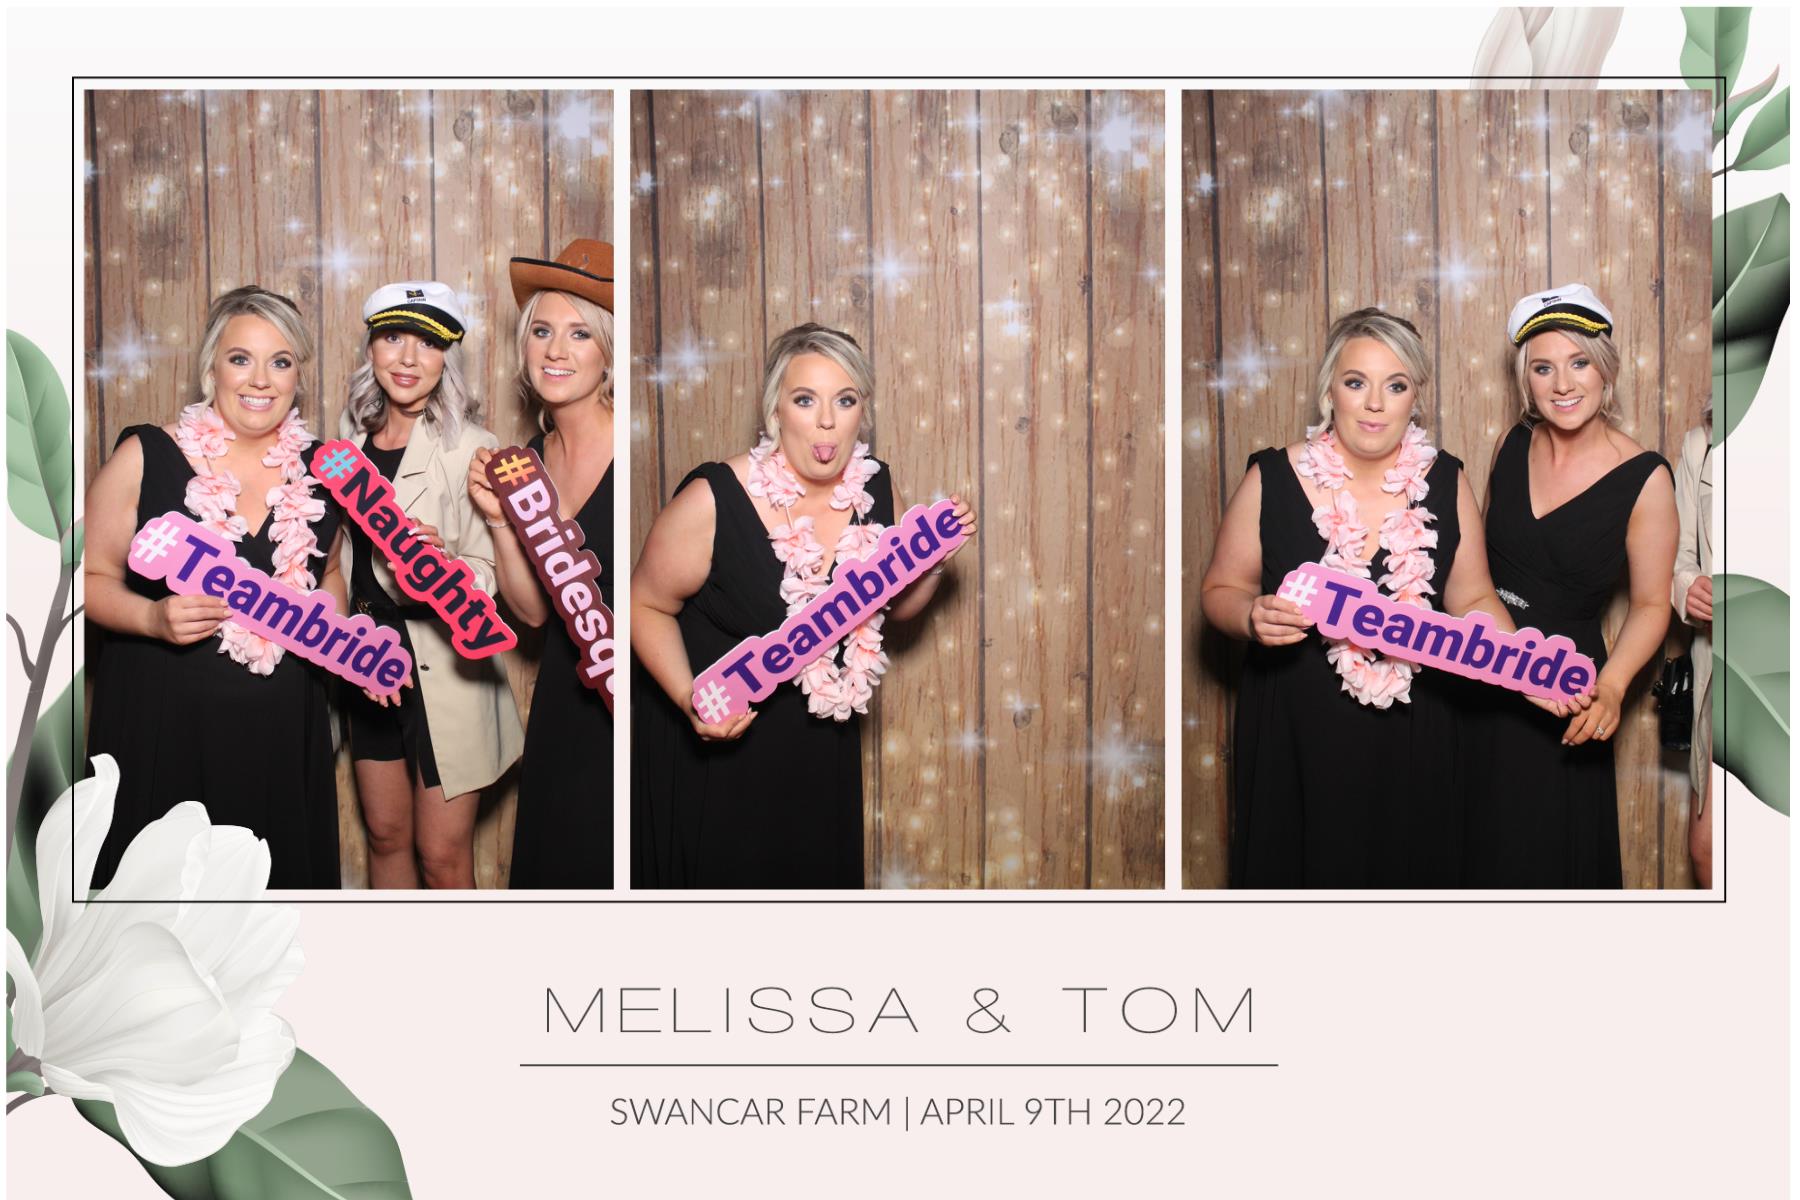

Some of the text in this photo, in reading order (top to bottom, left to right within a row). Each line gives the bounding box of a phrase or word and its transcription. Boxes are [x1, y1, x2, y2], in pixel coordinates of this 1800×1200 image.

[134, 520, 405, 688] #Teambride
[319, 447, 508, 650] #Naughty
[493, 454, 614, 700] #Bridesq
[697, 508, 964, 723] #Teambride
[1285, 571, 1589, 696] #Teambride
